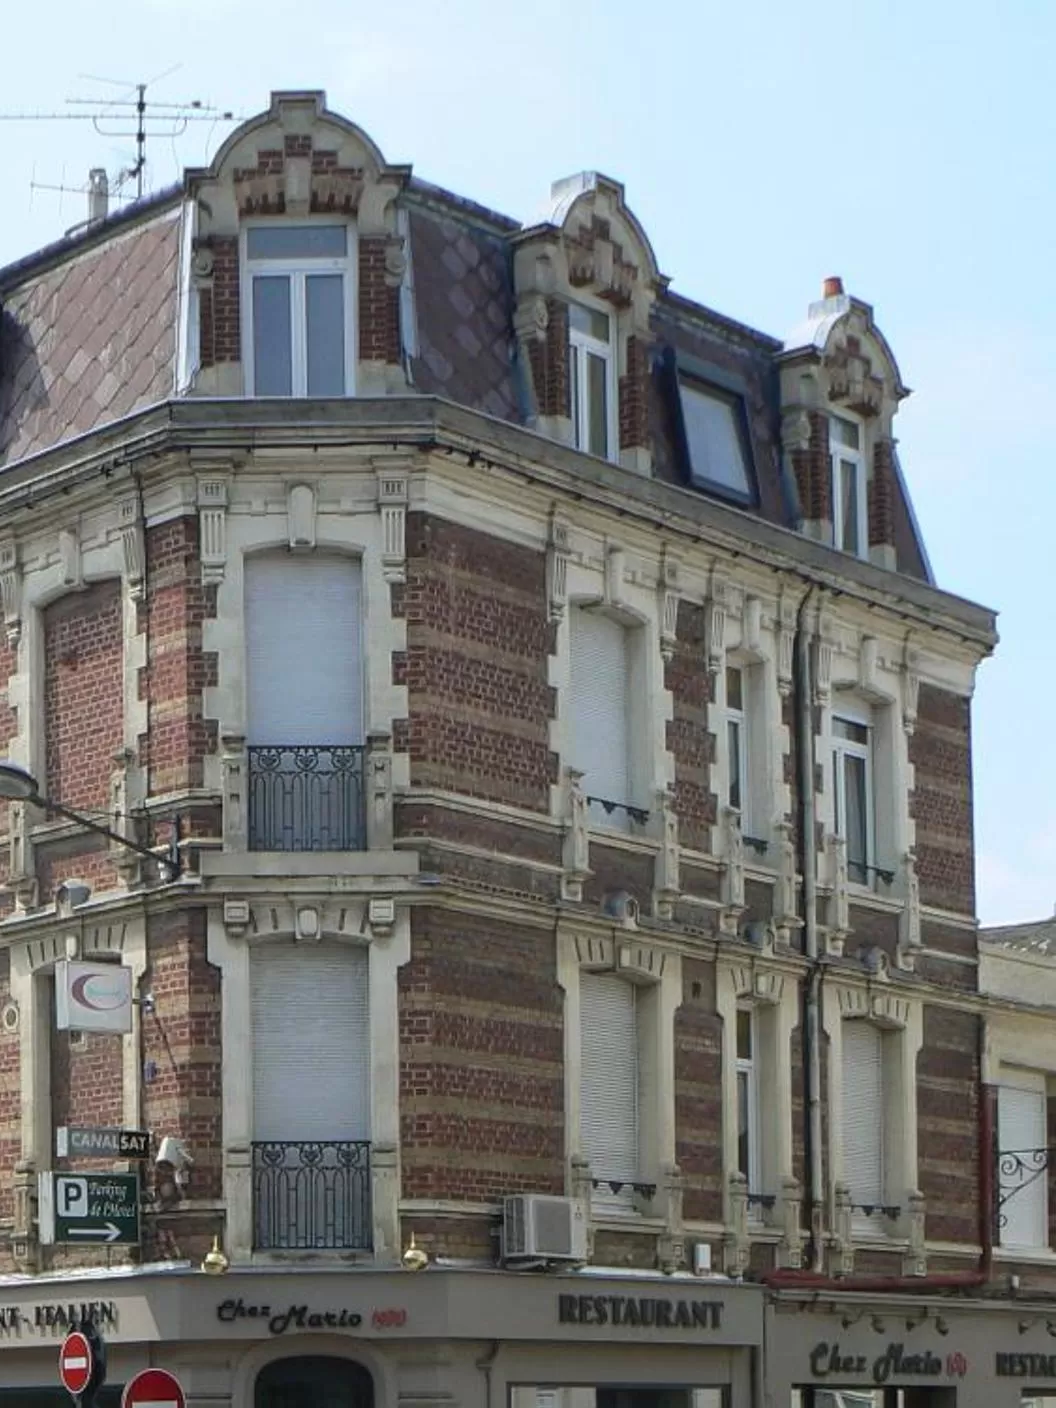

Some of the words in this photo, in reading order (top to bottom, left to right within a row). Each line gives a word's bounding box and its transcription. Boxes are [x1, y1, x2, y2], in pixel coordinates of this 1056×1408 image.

[64, 1182, 82, 1212] P
[217, 1297, 271, 1322] Chez
[269, 1304, 362, 1335] Mario
[559, 1293, 725, 1330] RESTAURANT
[809, 1341, 867, 1378] Chez
[872, 1342, 943, 1383] Mario
